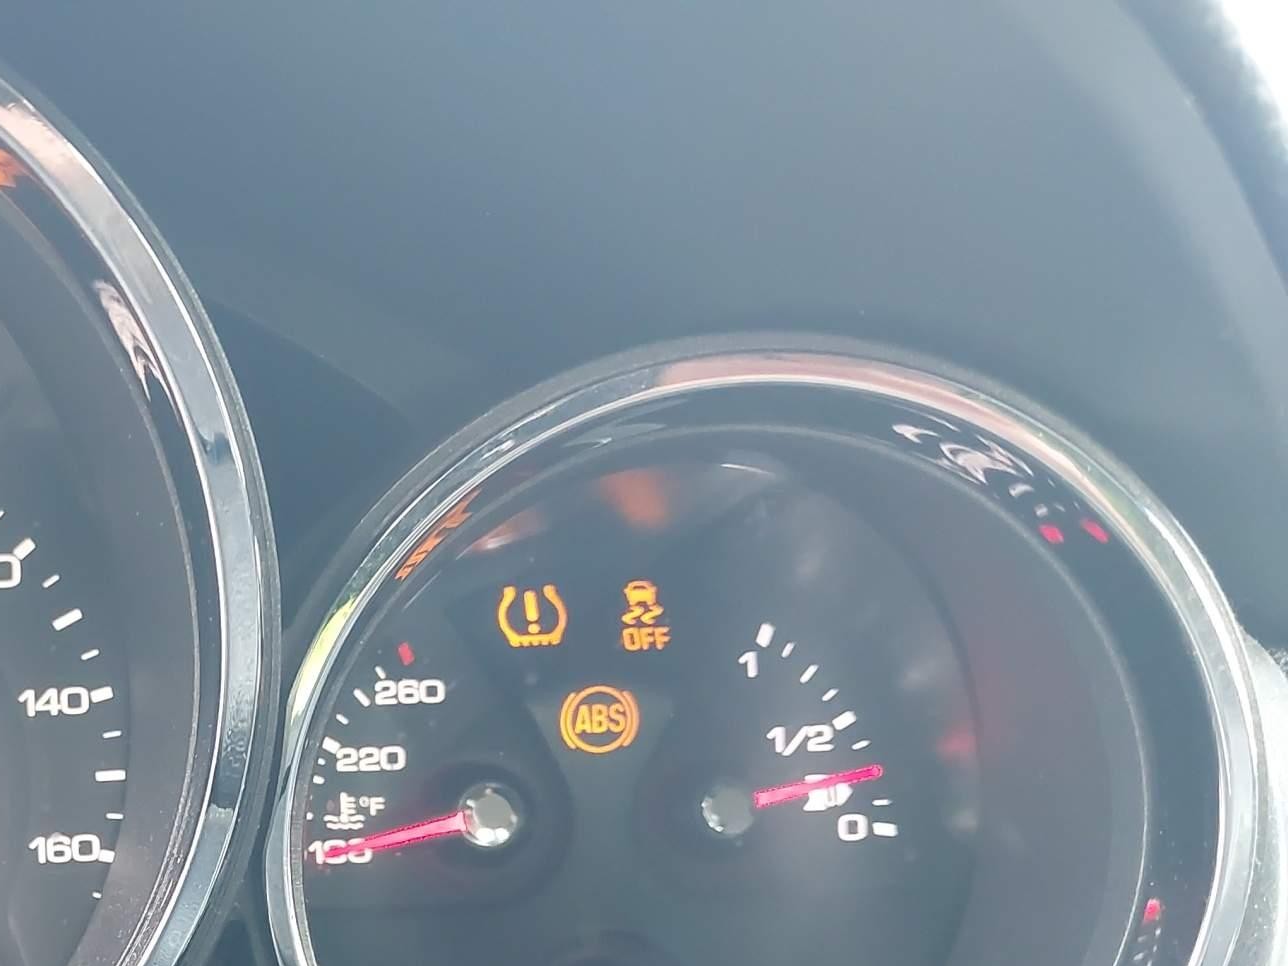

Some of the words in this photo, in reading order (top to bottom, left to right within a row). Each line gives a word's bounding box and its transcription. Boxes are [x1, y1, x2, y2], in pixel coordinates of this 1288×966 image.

[622, 627, 670, 651] OFF
[738, 651, 759, 678] 1
[19, 687, 90, 717] 140
[374, 679, 446, 705] 260
[574, 703, 626, 734] ABS
[766, 725, 835, 756] 1/2
[335, 745, 407, 772] 220
[837, 813, 868, 841] 0
[29, 833, 101, 864] 160
